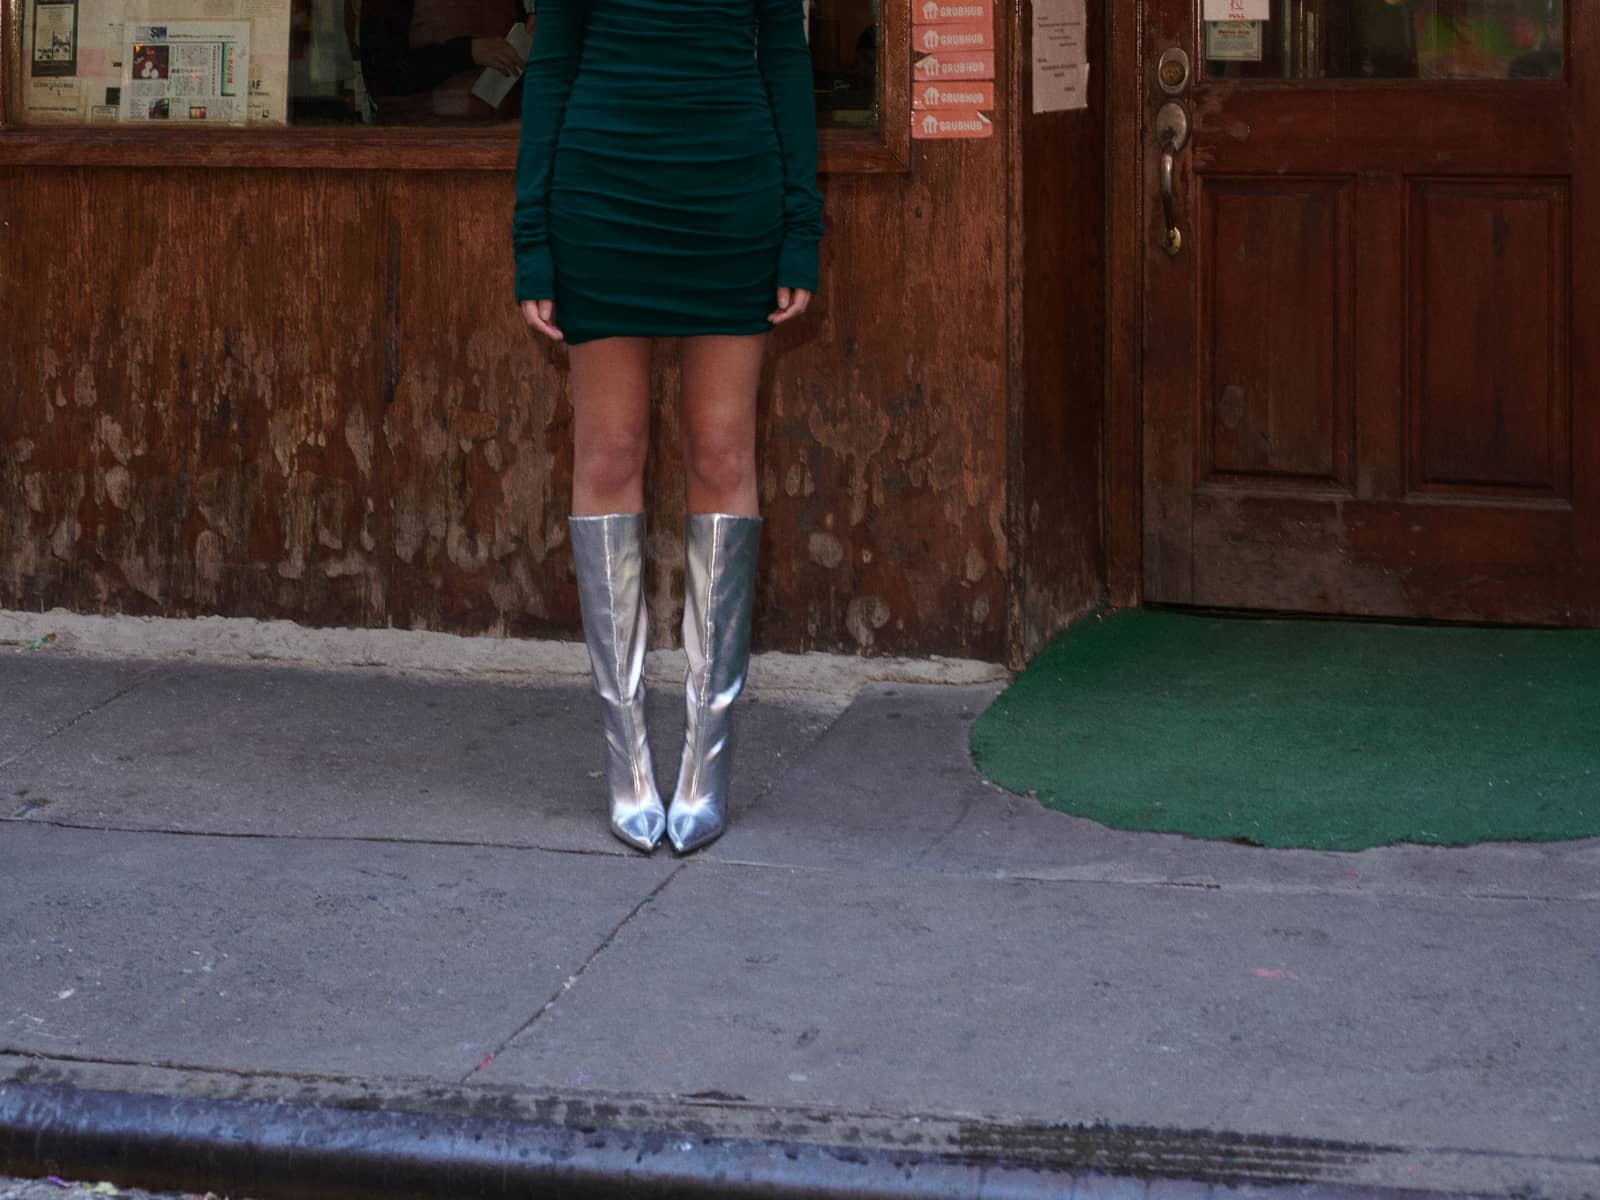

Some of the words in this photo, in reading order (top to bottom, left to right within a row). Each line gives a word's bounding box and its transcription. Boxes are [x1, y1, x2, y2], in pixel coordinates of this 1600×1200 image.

[940, 6, 984, 17] GRUBHUB
[940, 34, 985, 46] GRUBHUB
[941, 62, 985, 73] GRUBHUB
[940, 92, 985, 103] GRUBHUB
[939, 120, 983, 131] GRUBHUB
